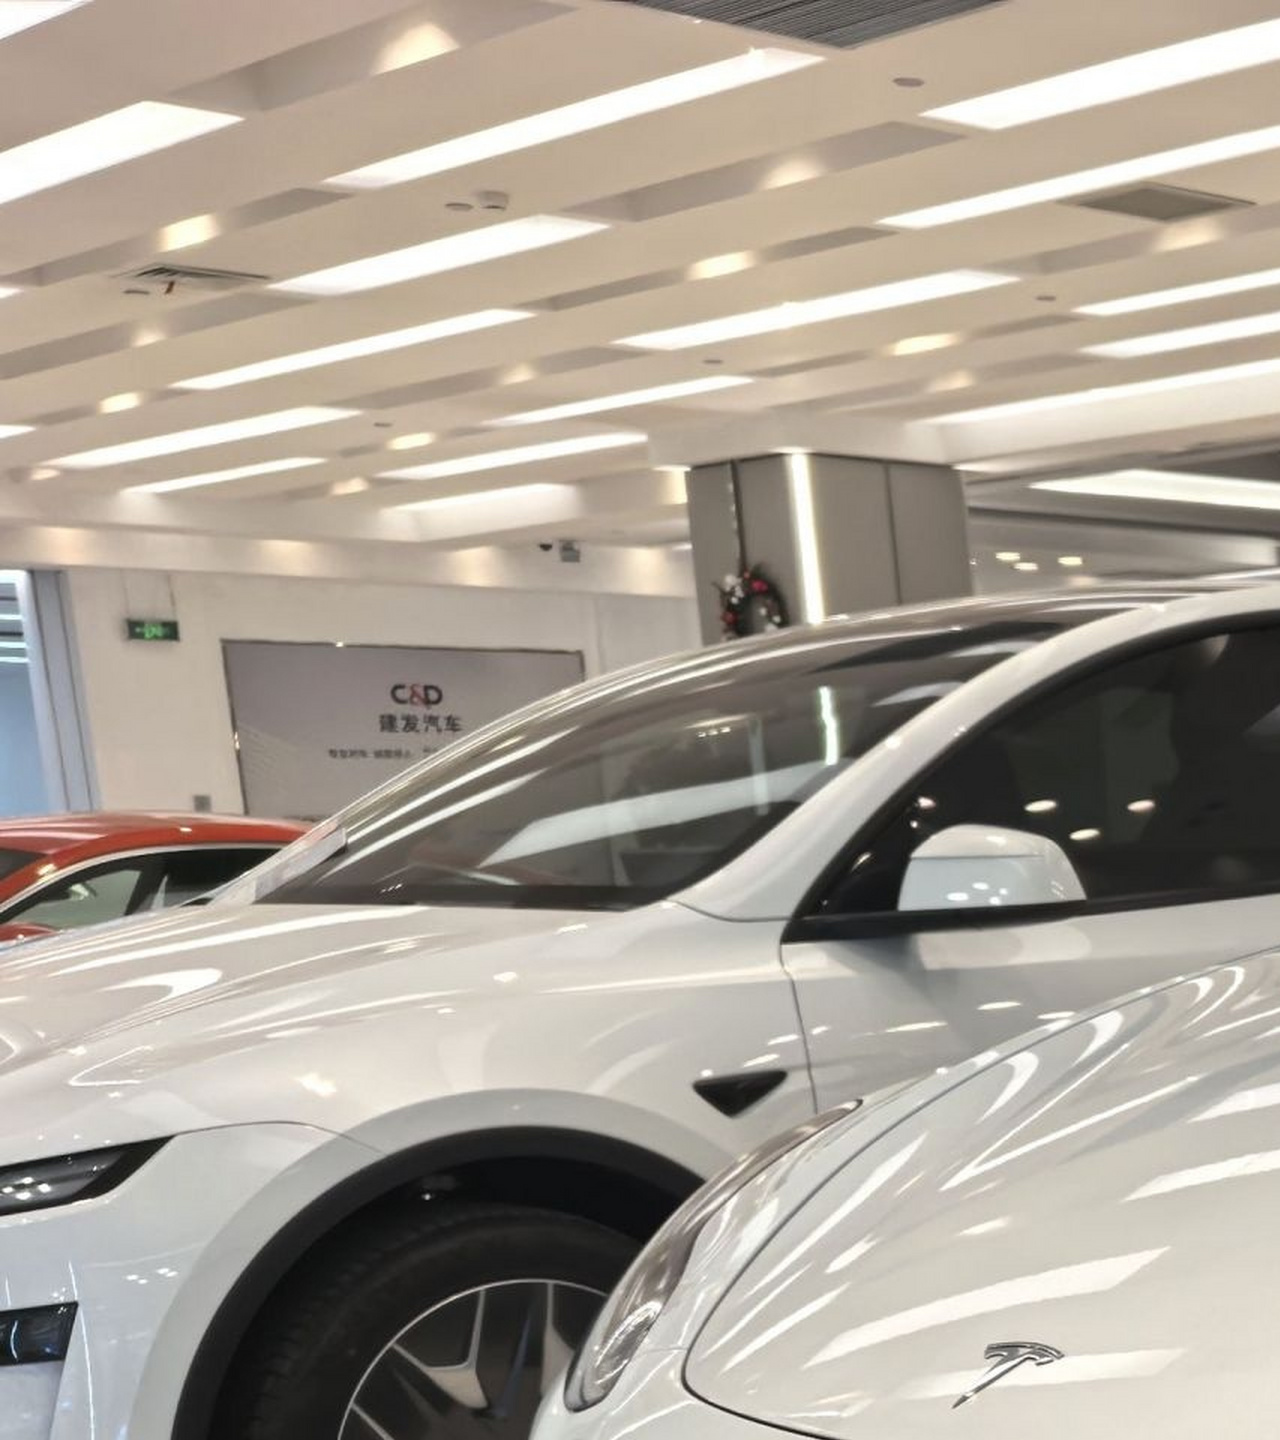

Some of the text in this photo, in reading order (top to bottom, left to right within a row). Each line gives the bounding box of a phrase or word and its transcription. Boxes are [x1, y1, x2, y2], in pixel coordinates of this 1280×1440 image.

[390, 684, 443, 706] C&D
[379, 714, 462, 733] 建发汽车
